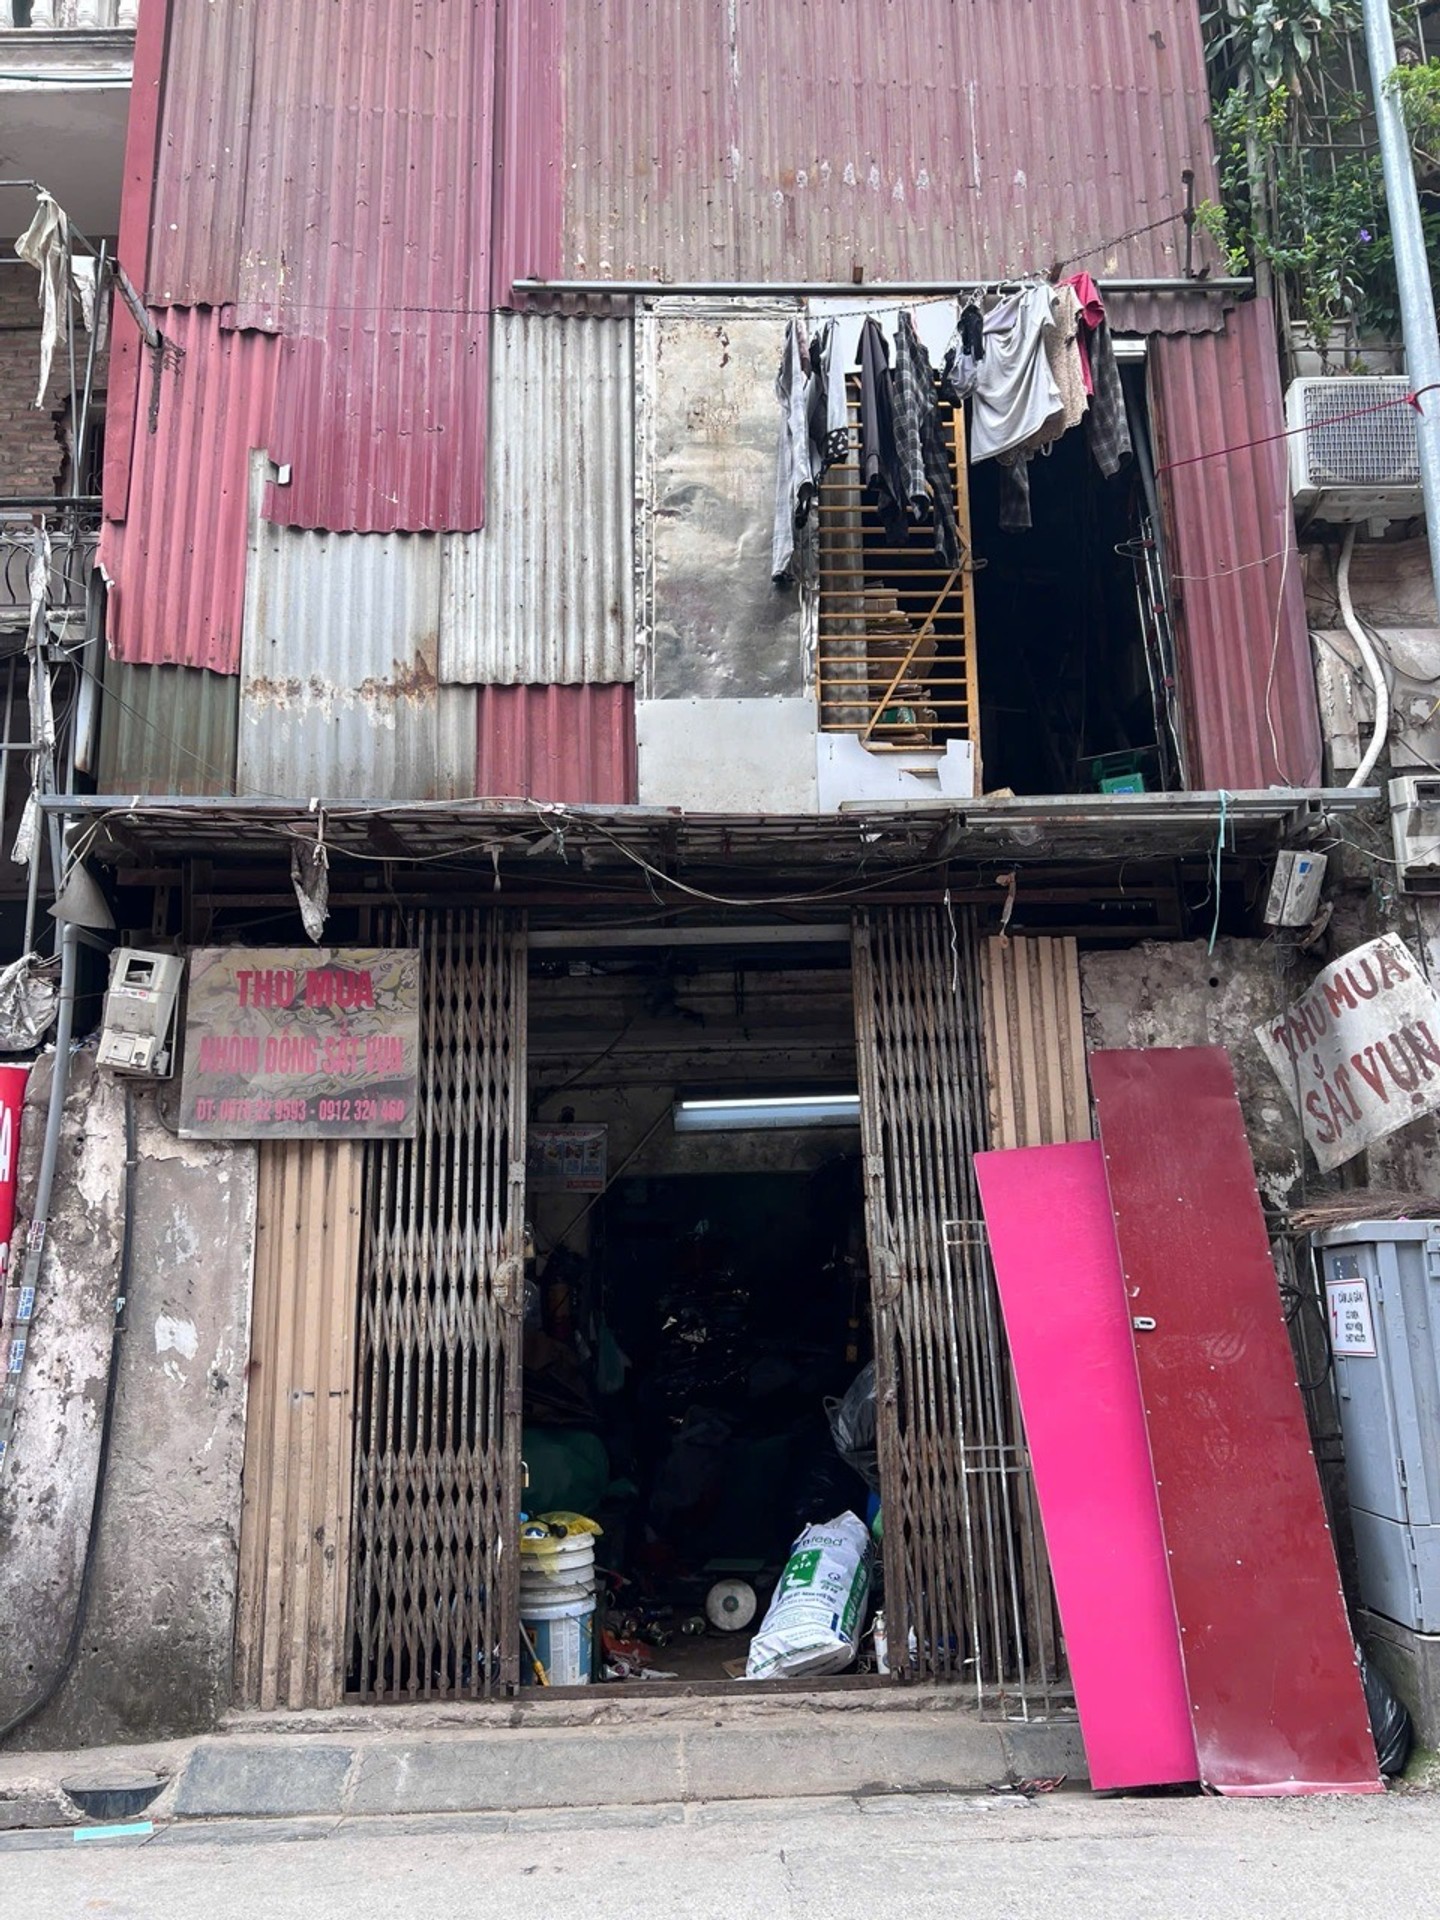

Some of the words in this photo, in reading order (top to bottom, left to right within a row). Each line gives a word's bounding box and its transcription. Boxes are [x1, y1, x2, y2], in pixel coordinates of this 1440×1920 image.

[236, 969, 295, 1009] THU
[305, 969, 375, 1009] MUA
[1272, 996, 1328, 1061] THU
[1322, 949, 1411, 1018] MUA
[319, 1099, 351, 1121] 0912
[354, 1099, 377, 1121] 324
[1306, 1053, 1363, 1145] SẮT
